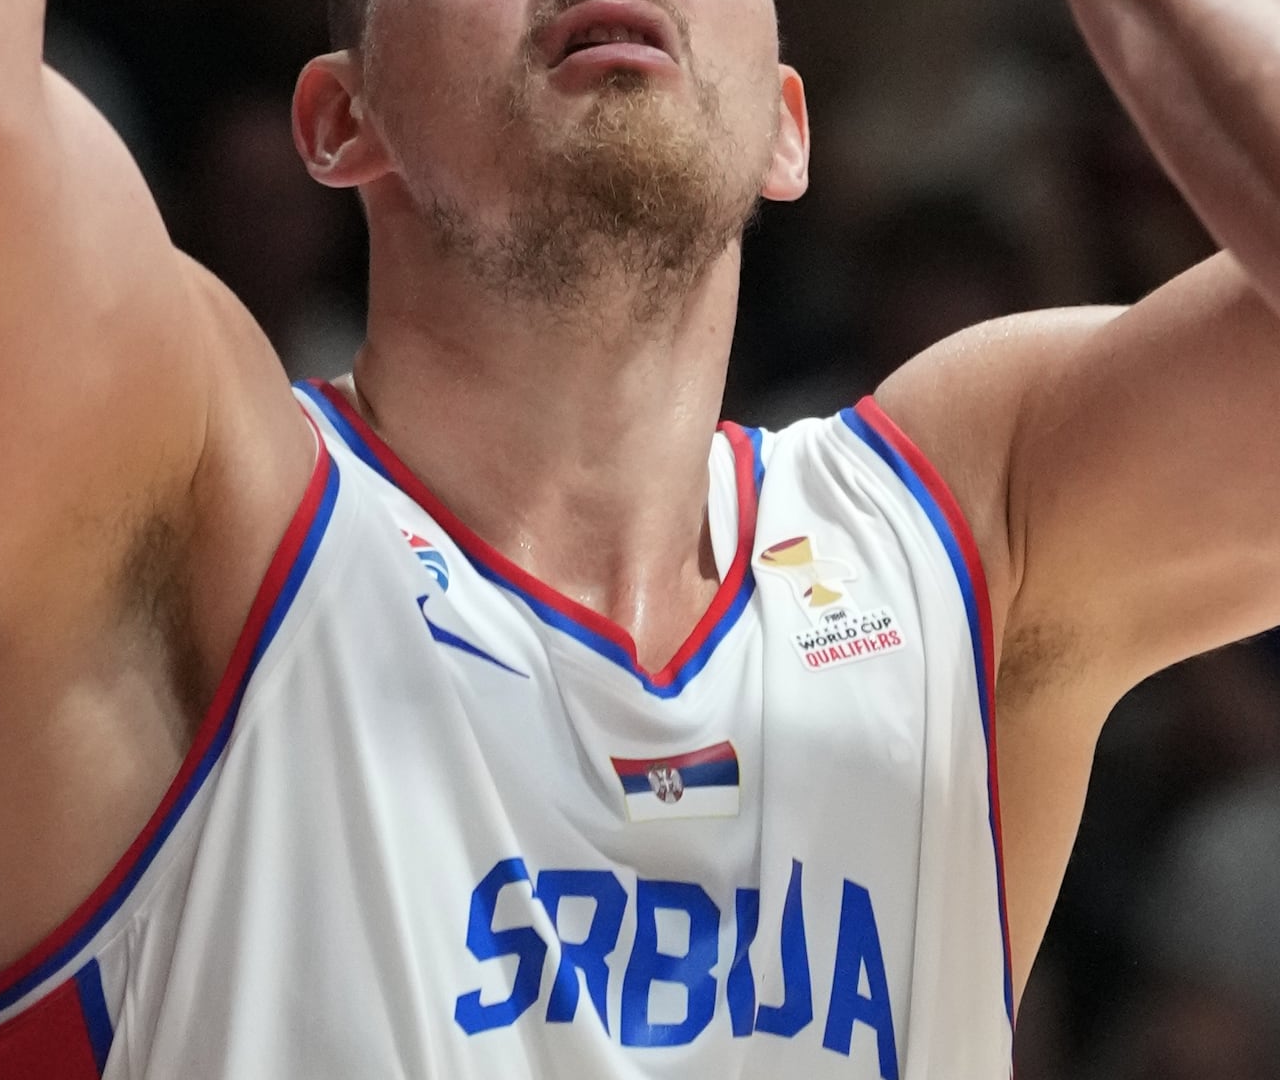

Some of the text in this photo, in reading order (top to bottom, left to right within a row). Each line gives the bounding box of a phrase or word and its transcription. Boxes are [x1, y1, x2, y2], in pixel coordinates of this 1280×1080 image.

[799, 617, 892, 651] WORLD CUP
[805, 630, 902, 668] QUALIFIERS
[454, 856, 900, 1080] SRBIJA
